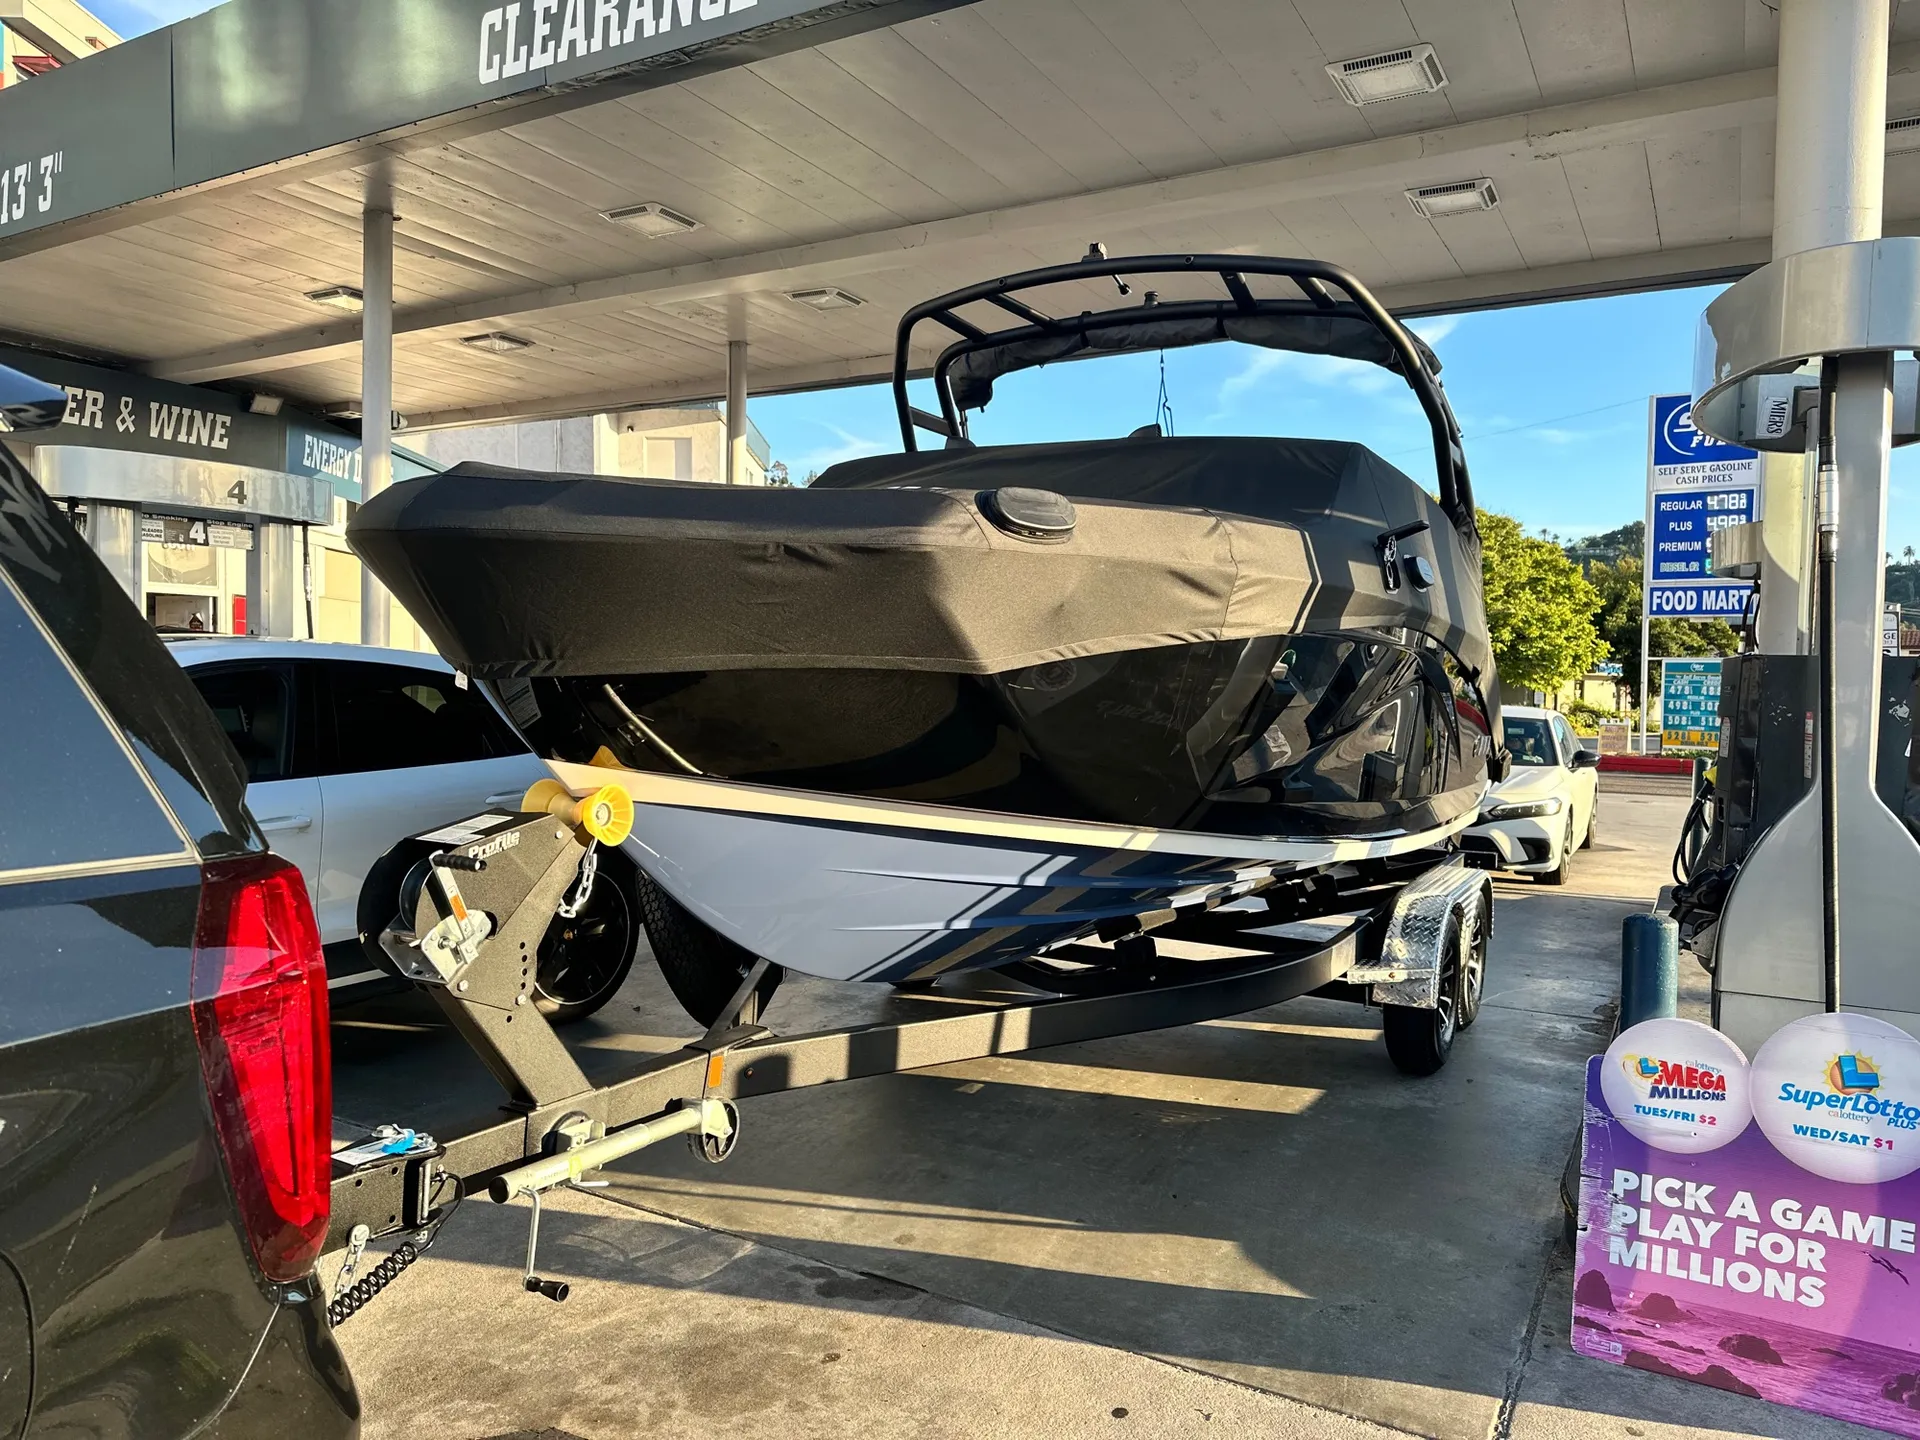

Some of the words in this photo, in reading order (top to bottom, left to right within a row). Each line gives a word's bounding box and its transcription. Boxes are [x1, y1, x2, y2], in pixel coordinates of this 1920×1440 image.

[479, 0, 758, 84] CLEARA
[1, 161, 31, 225] 13'
[51, 384, 105, 429] ER
[116, 396, 136, 433] &
[150, 402, 232, 450] WINE
[1766, 400, 1789, 435] MIERS
[303, 434, 352, 480] ENERGY
[1658, 466, 1678, 476] SELF
[1680, 464, 1707, 475] SERVE
[1709, 461, 1753, 473] GASOLINE
[1675, 476, 1699, 485] CASH
[1702, 473, 1733, 484] PRICES
[227, 480, 247, 504] 4
[1660, 500, 1703, 511] REGULAR
[152, 514, 188, 522] Smoking
[227, 521, 253, 529] Engine
[1669, 521, 1693, 531] PLUS
[189, 521, 206, 543] 4
[1659, 541, 1702, 552] PREMIUM
[1659, 562, 1688, 572] DIESEL
[1652, 590, 1698, 611] FOOD
[1702, 589, 1752, 611] MART
[468, 831, 520, 859] Profile
[1654, 1060, 1727, 1092] MEGA
[1649, 1085, 1727, 1101] MILLIONS
[1778, 1083, 1920, 1121] SuperLotto
[1634, 1104, 1696, 1123] TUES/FRI
[1699, 1114, 1717, 1126] $2
[1887, 1117, 1917, 1130] PLUS
[1793, 1123, 1870, 1146] WED/SAT
[1873, 1137, 1894, 1150] $1
[1613, 1168, 1716, 1215] PICK
[1725, 1190, 1761, 1224] A
[1770, 1198, 1916, 1253] GAME
[1611, 1203, 1723, 1249] PLAY
[1734, 1226, 1827, 1272] FOR
[1609, 1235, 1827, 1308] MILLIONS
